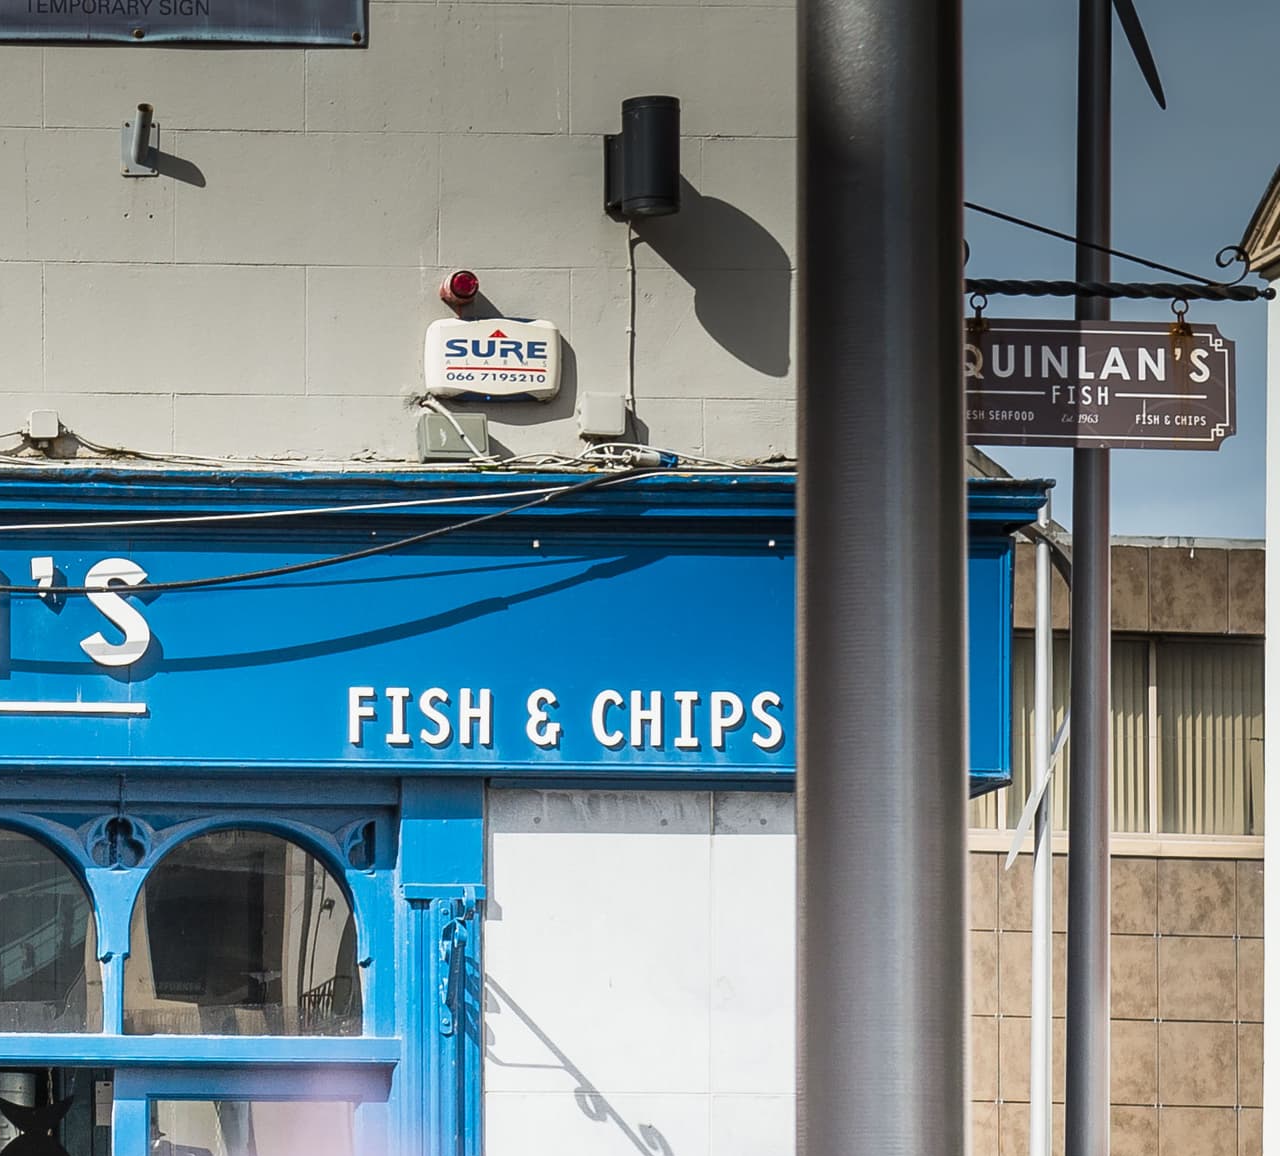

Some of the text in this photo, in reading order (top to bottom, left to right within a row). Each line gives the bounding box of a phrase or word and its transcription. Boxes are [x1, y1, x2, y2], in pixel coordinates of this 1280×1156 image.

[159, 0, 210, 16] SIGN
[445, 339, 548, 362] SURE
[446, 373, 546, 383] 066 7195210
[1051, 385, 1109, 406] FISH
[966, 409, 1035, 421] ESH SEAFOOD
[1077, 413, 1099, 424] 1963
[1135, 413, 1207, 427] FISH & CHIPS
[349, 686, 783, 749] FISH & CHIPS
